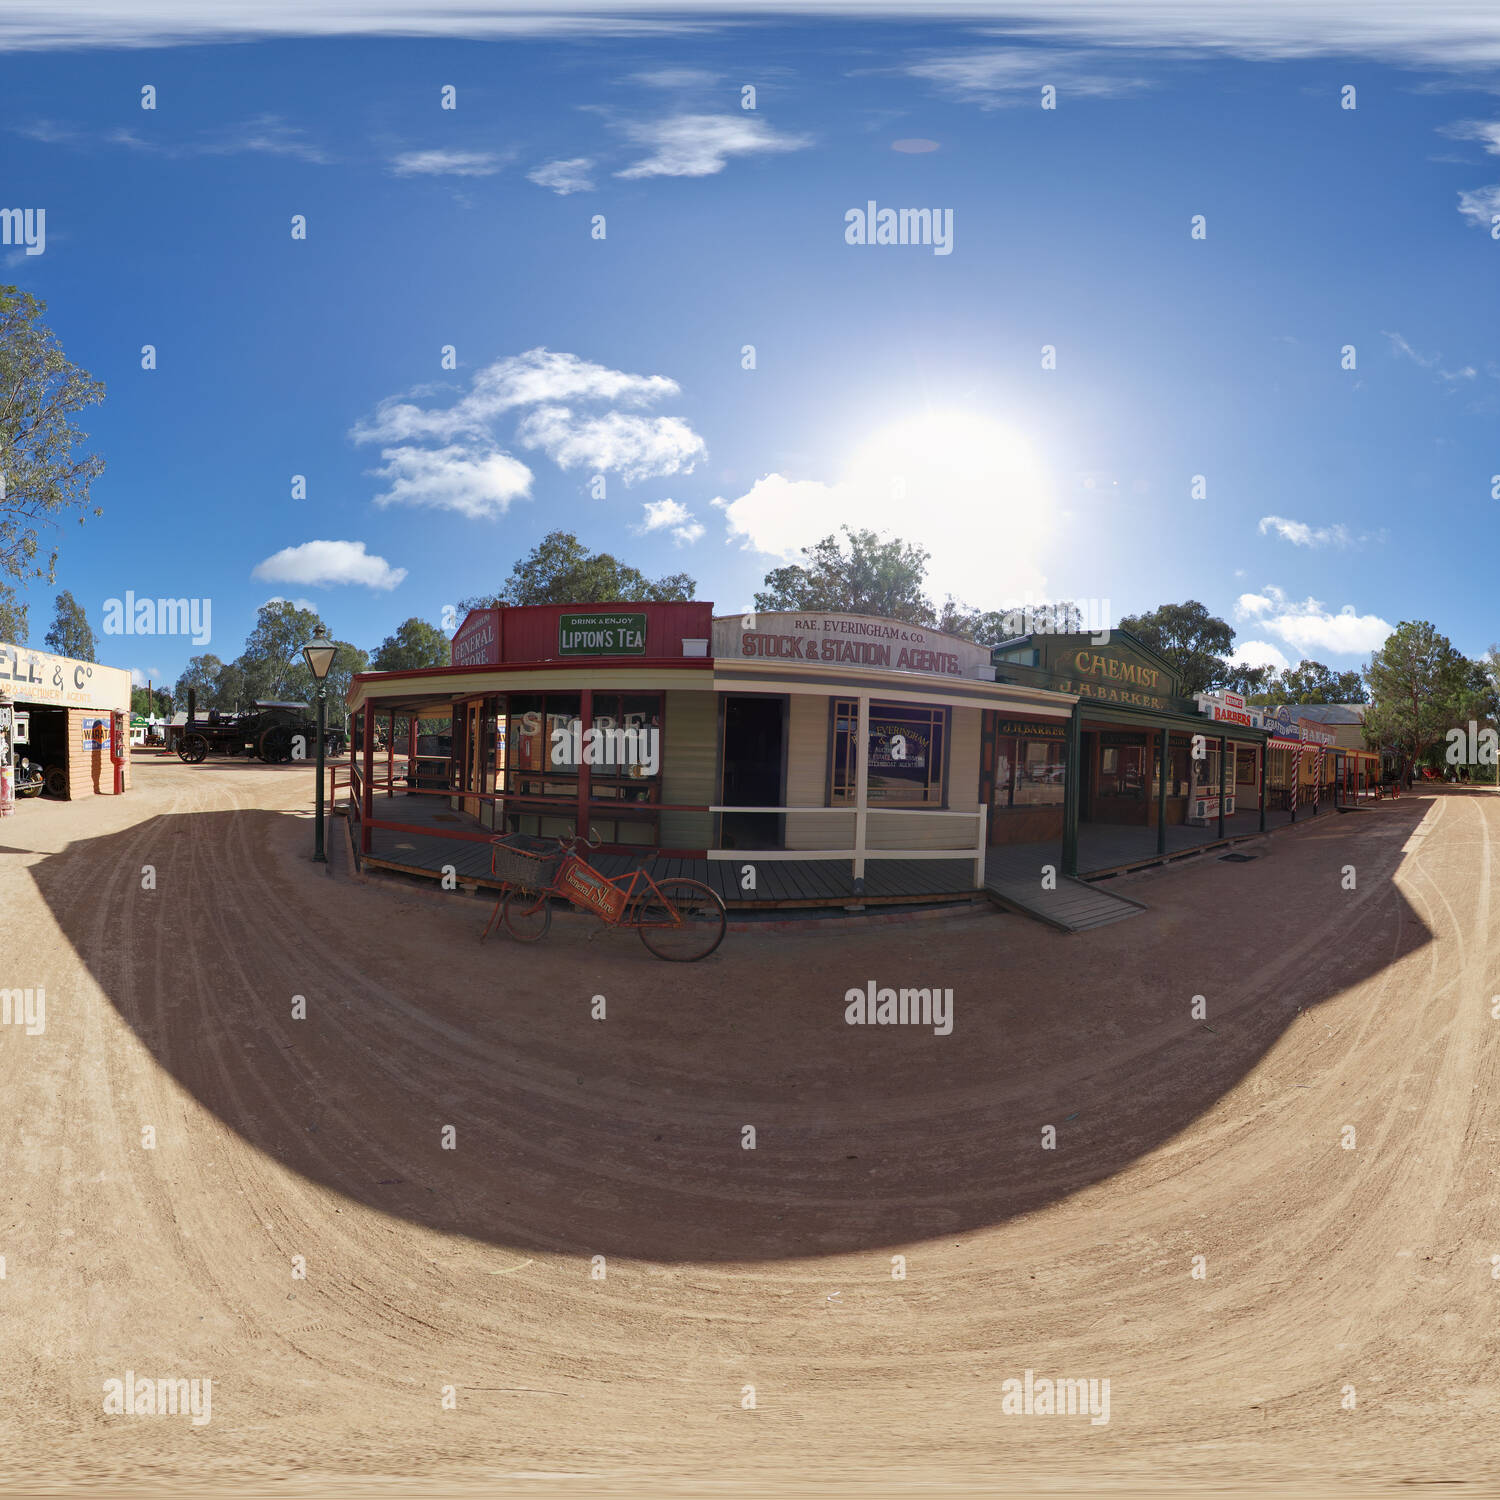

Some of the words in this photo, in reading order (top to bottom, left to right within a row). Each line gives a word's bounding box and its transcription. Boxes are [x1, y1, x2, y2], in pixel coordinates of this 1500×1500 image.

[571, 618, 597, 626] DRINK
[605, 617, 634, 626] ENJOY
[794, 619, 822, 632] RAE.
[823, 620, 899, 642] EVERINGHAM
[900, 632, 909, 641] &
[910, 632, 926, 644] CO.
[455, 625, 494, 660] GENERAL
[562, 630, 613, 650] LIPTON'S
[617, 629, 643, 648] TEA
[742, 633, 805, 659] STOCK
[806, 640, 819, 661] &
[821, 639, 892, 667] STATION
[896, 647, 963, 676] AGENTS.
[52, 665, 64, 691] &
[1075, 651, 1160, 689] CHEMIST
[1214, 706, 1251, 727] BARBERS
[1302, 727, 1337, 745] BAKERY
[565, 863, 595, 897] General
[591, 886, 615, 914] Store
